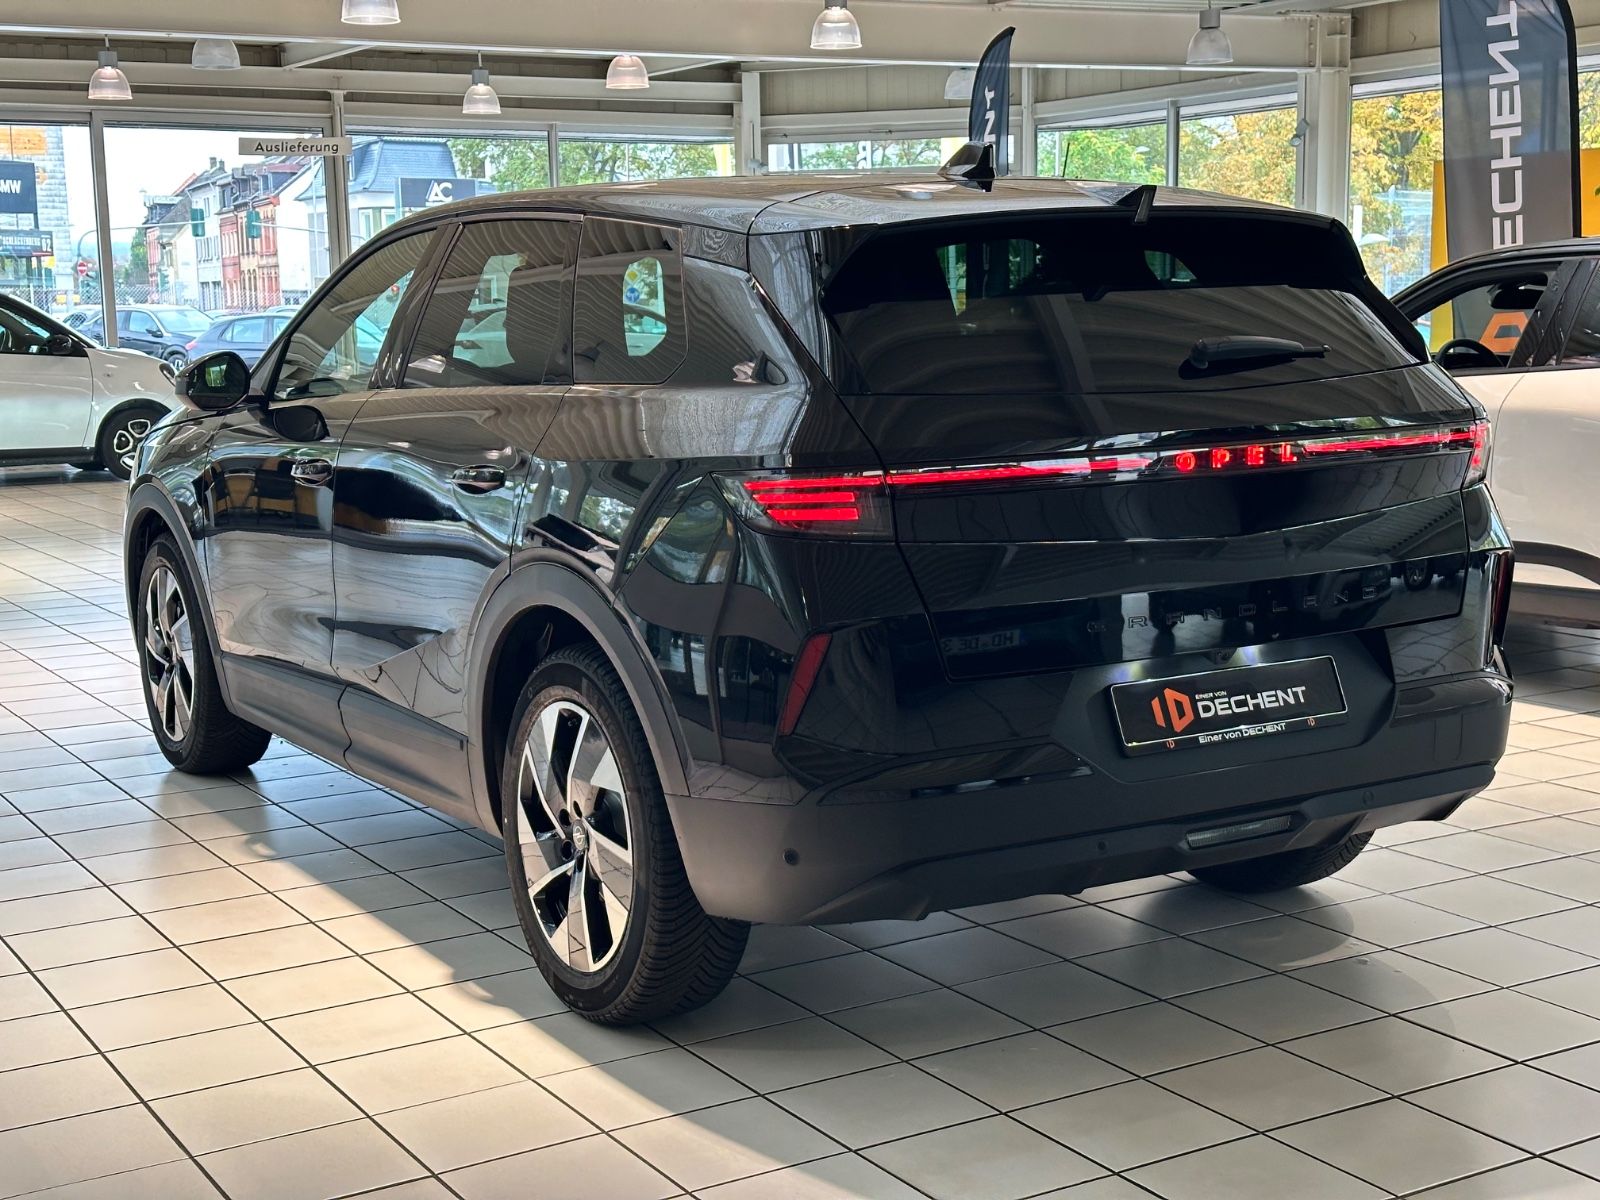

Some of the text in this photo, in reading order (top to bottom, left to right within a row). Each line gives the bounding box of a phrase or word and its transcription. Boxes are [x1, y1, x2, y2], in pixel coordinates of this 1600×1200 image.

[984, 85, 996, 143] NT
[255, 141, 339, 154] Auslieferung
[0, 179, 21, 194] MW
[1175, 442, 1298, 473] OPEL
[1195, 692, 1213, 700] EINER
[1197, 686, 1306, 719] DECHENT
[1199, 722, 1286, 744] Einer von DECHENT
